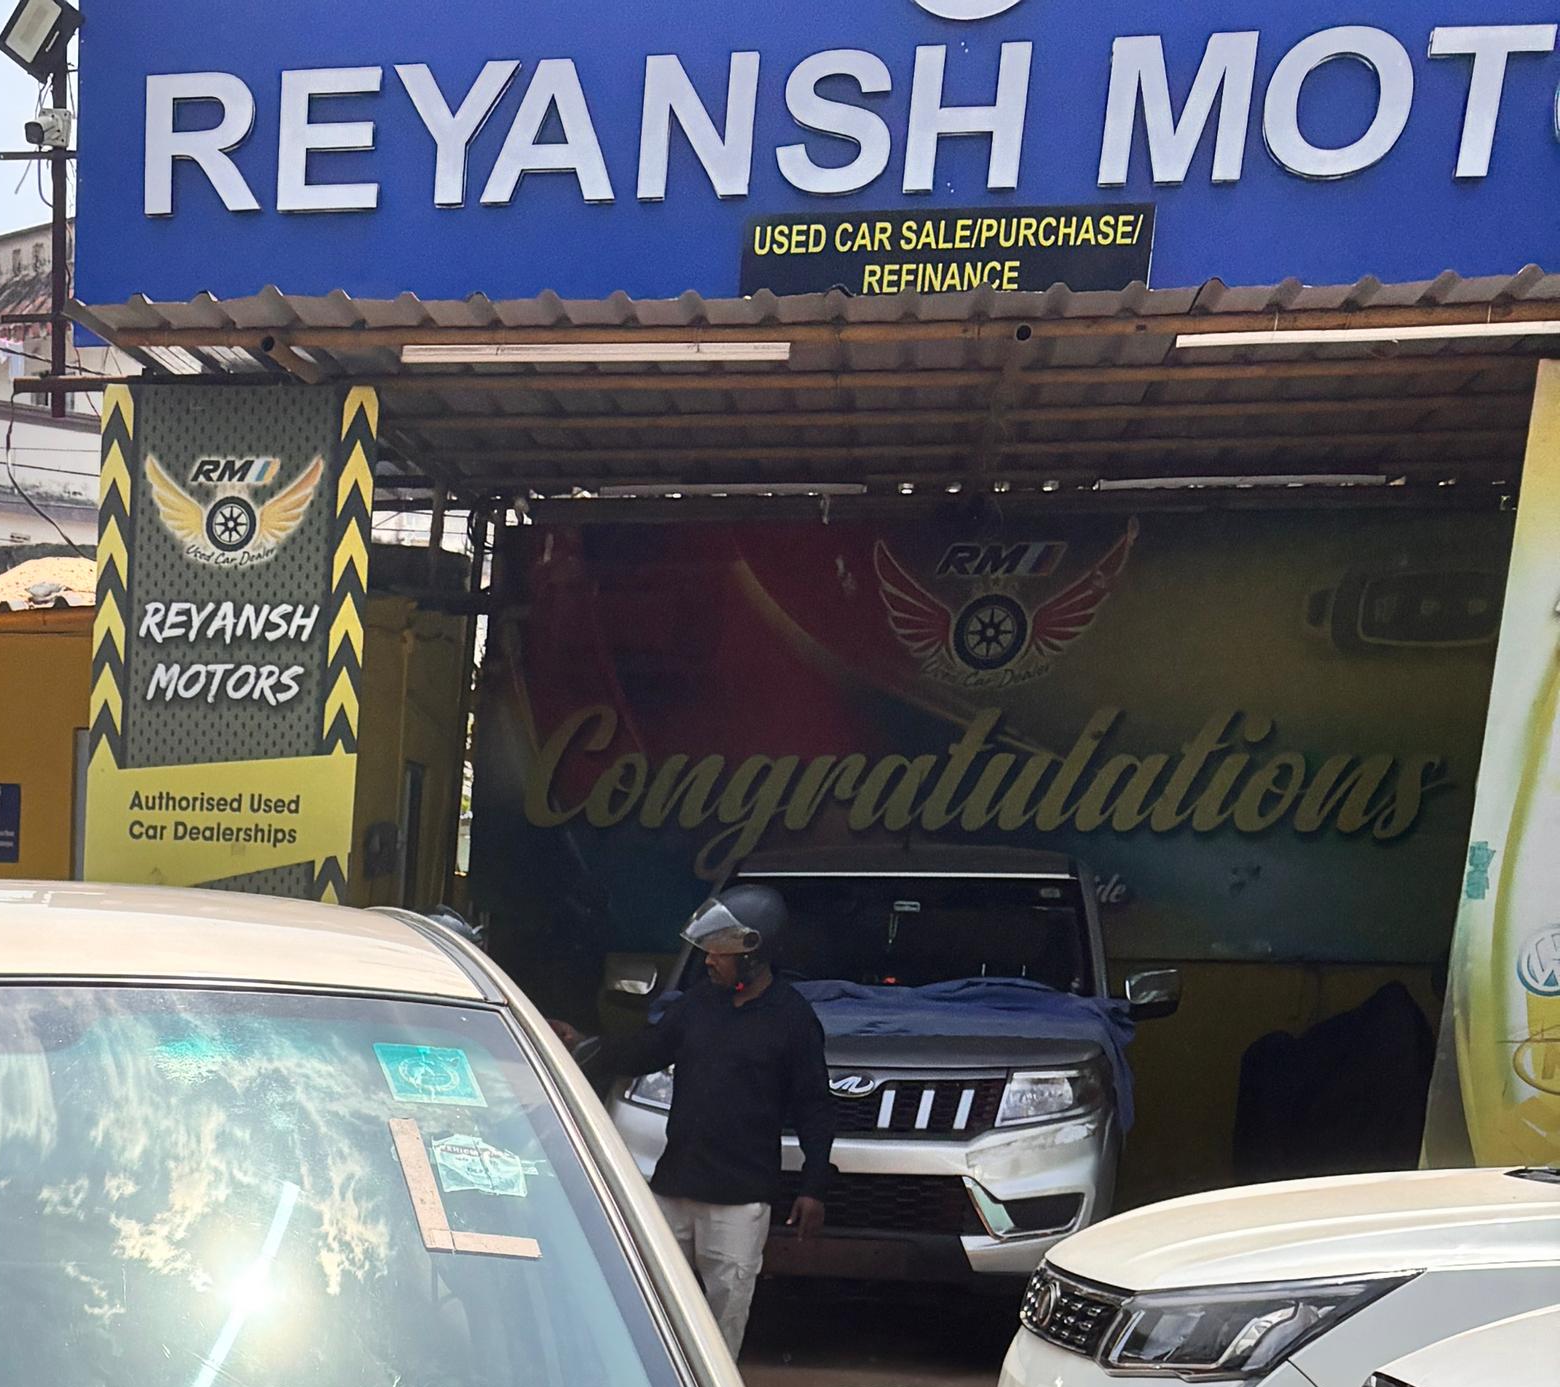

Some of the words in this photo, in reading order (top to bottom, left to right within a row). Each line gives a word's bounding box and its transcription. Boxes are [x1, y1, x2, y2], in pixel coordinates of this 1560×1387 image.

[143, 41, 1034, 218] REYANSH
[1097, 24, 1560, 188] MOT
[754, 224, 827, 256] USED
[834, 221, 892, 252] CAR
[900, 214, 1145, 251] SALE/PURCHASE/
[862, 259, 1021, 294] REFINANCE
[185, 544, 214, 563] Used
[215, 553, 237, 566] Car
[238, 548, 276, 567] Dealer
[138, 600, 321, 644] REYANSH
[145, 662, 306, 706] MOTORS
[129, 790, 243, 813] Authorised
[249, 793, 302, 814] Used
[525, 704, 1454, 886] Congratulations
[128, 819, 168, 841] Car
[173, 820, 298, 849] Dealerships
